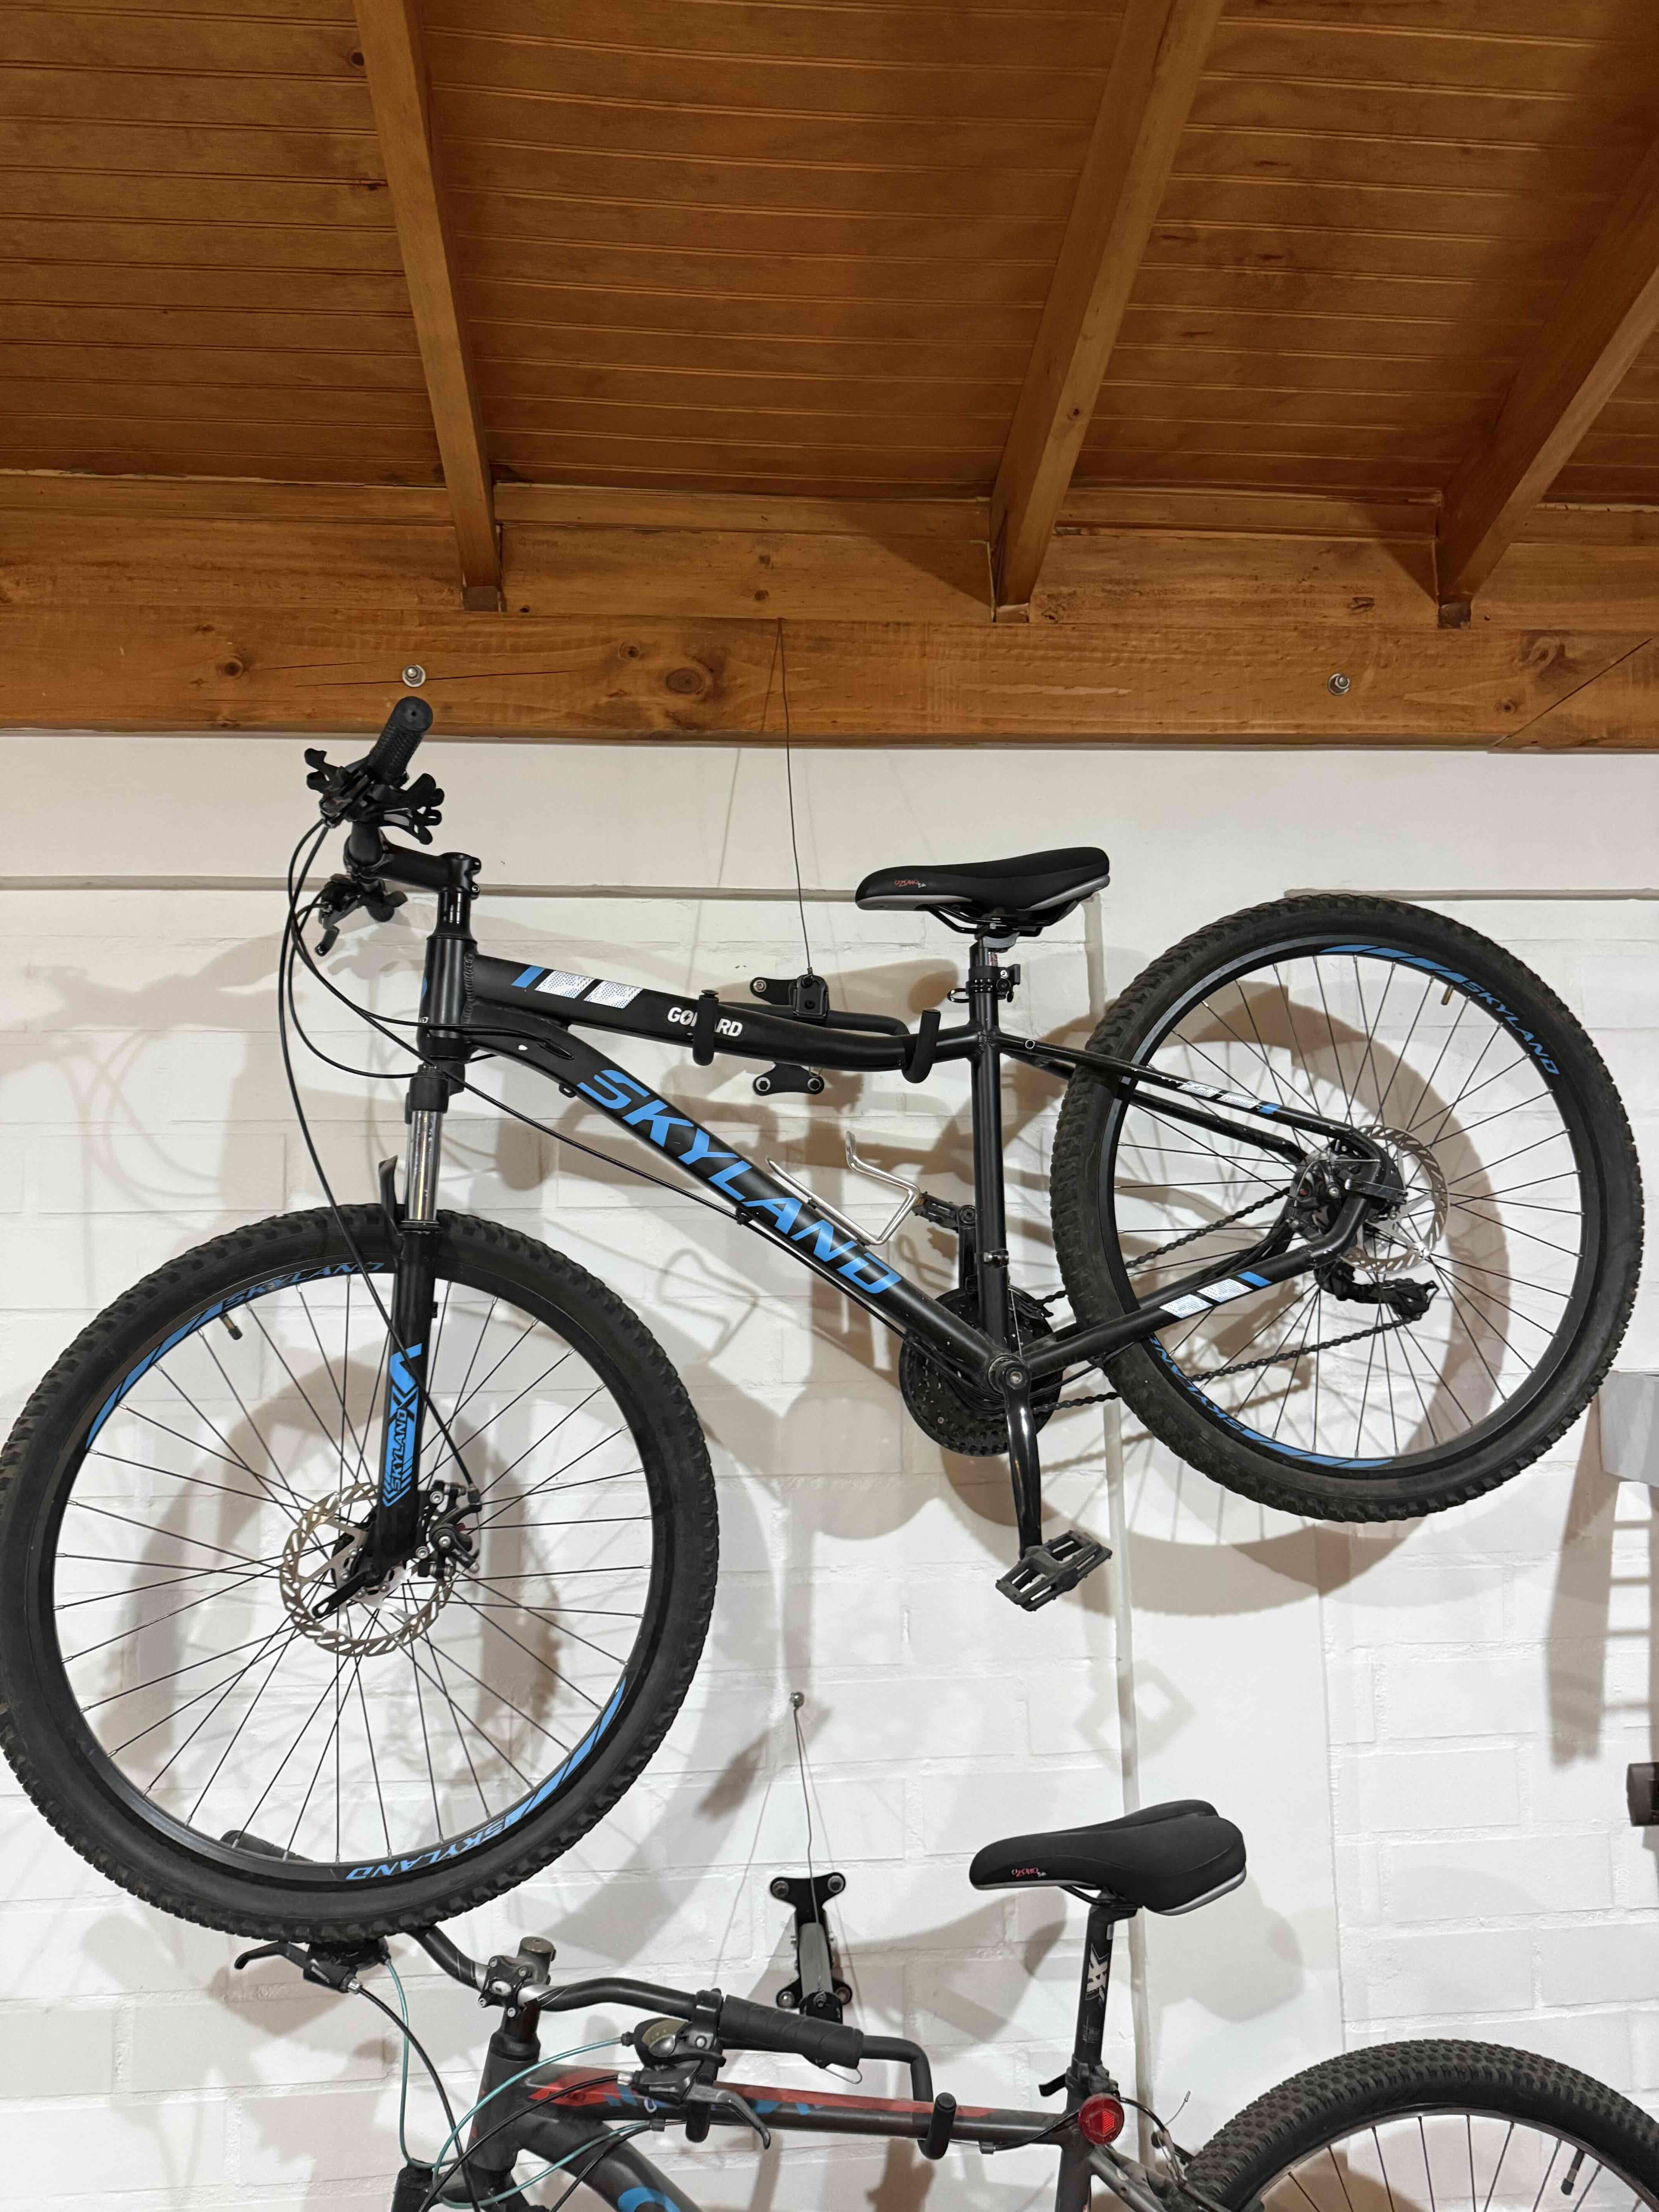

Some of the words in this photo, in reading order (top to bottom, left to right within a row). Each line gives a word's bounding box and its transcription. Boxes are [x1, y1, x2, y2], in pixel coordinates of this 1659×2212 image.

[1461, 981, 1560, 1075] SKYLAND
[577, 1069, 902, 1294] SKYLAND
[390, 1408, 408, 1491] SKYLAND
[345, 1819, 503, 1881] SKYLAND
